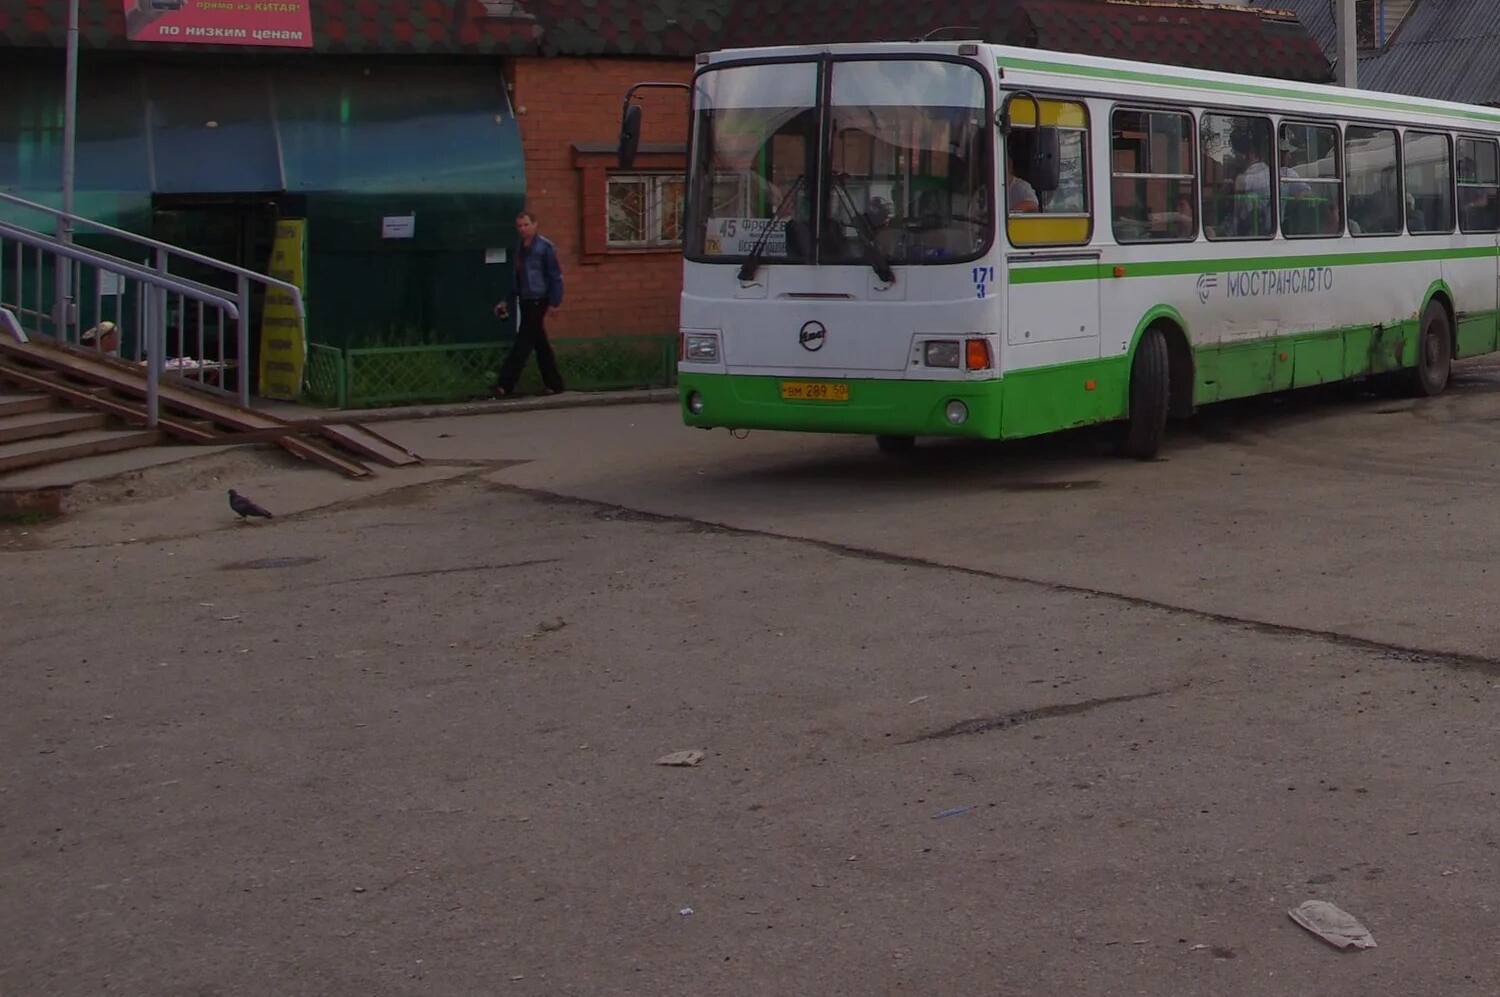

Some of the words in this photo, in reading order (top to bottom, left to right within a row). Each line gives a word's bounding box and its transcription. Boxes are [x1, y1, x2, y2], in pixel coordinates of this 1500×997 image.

[159, 25, 179, 35] по
[185, 26, 246, 37] низким
[252, 29, 303, 41] ценам
[720, 220, 737, 237] 45
[972, 266, 994, 283] 171
[1226, 267, 1333, 298] МОСТРАНСАВТО
[976, 284, 985, 299] 3
